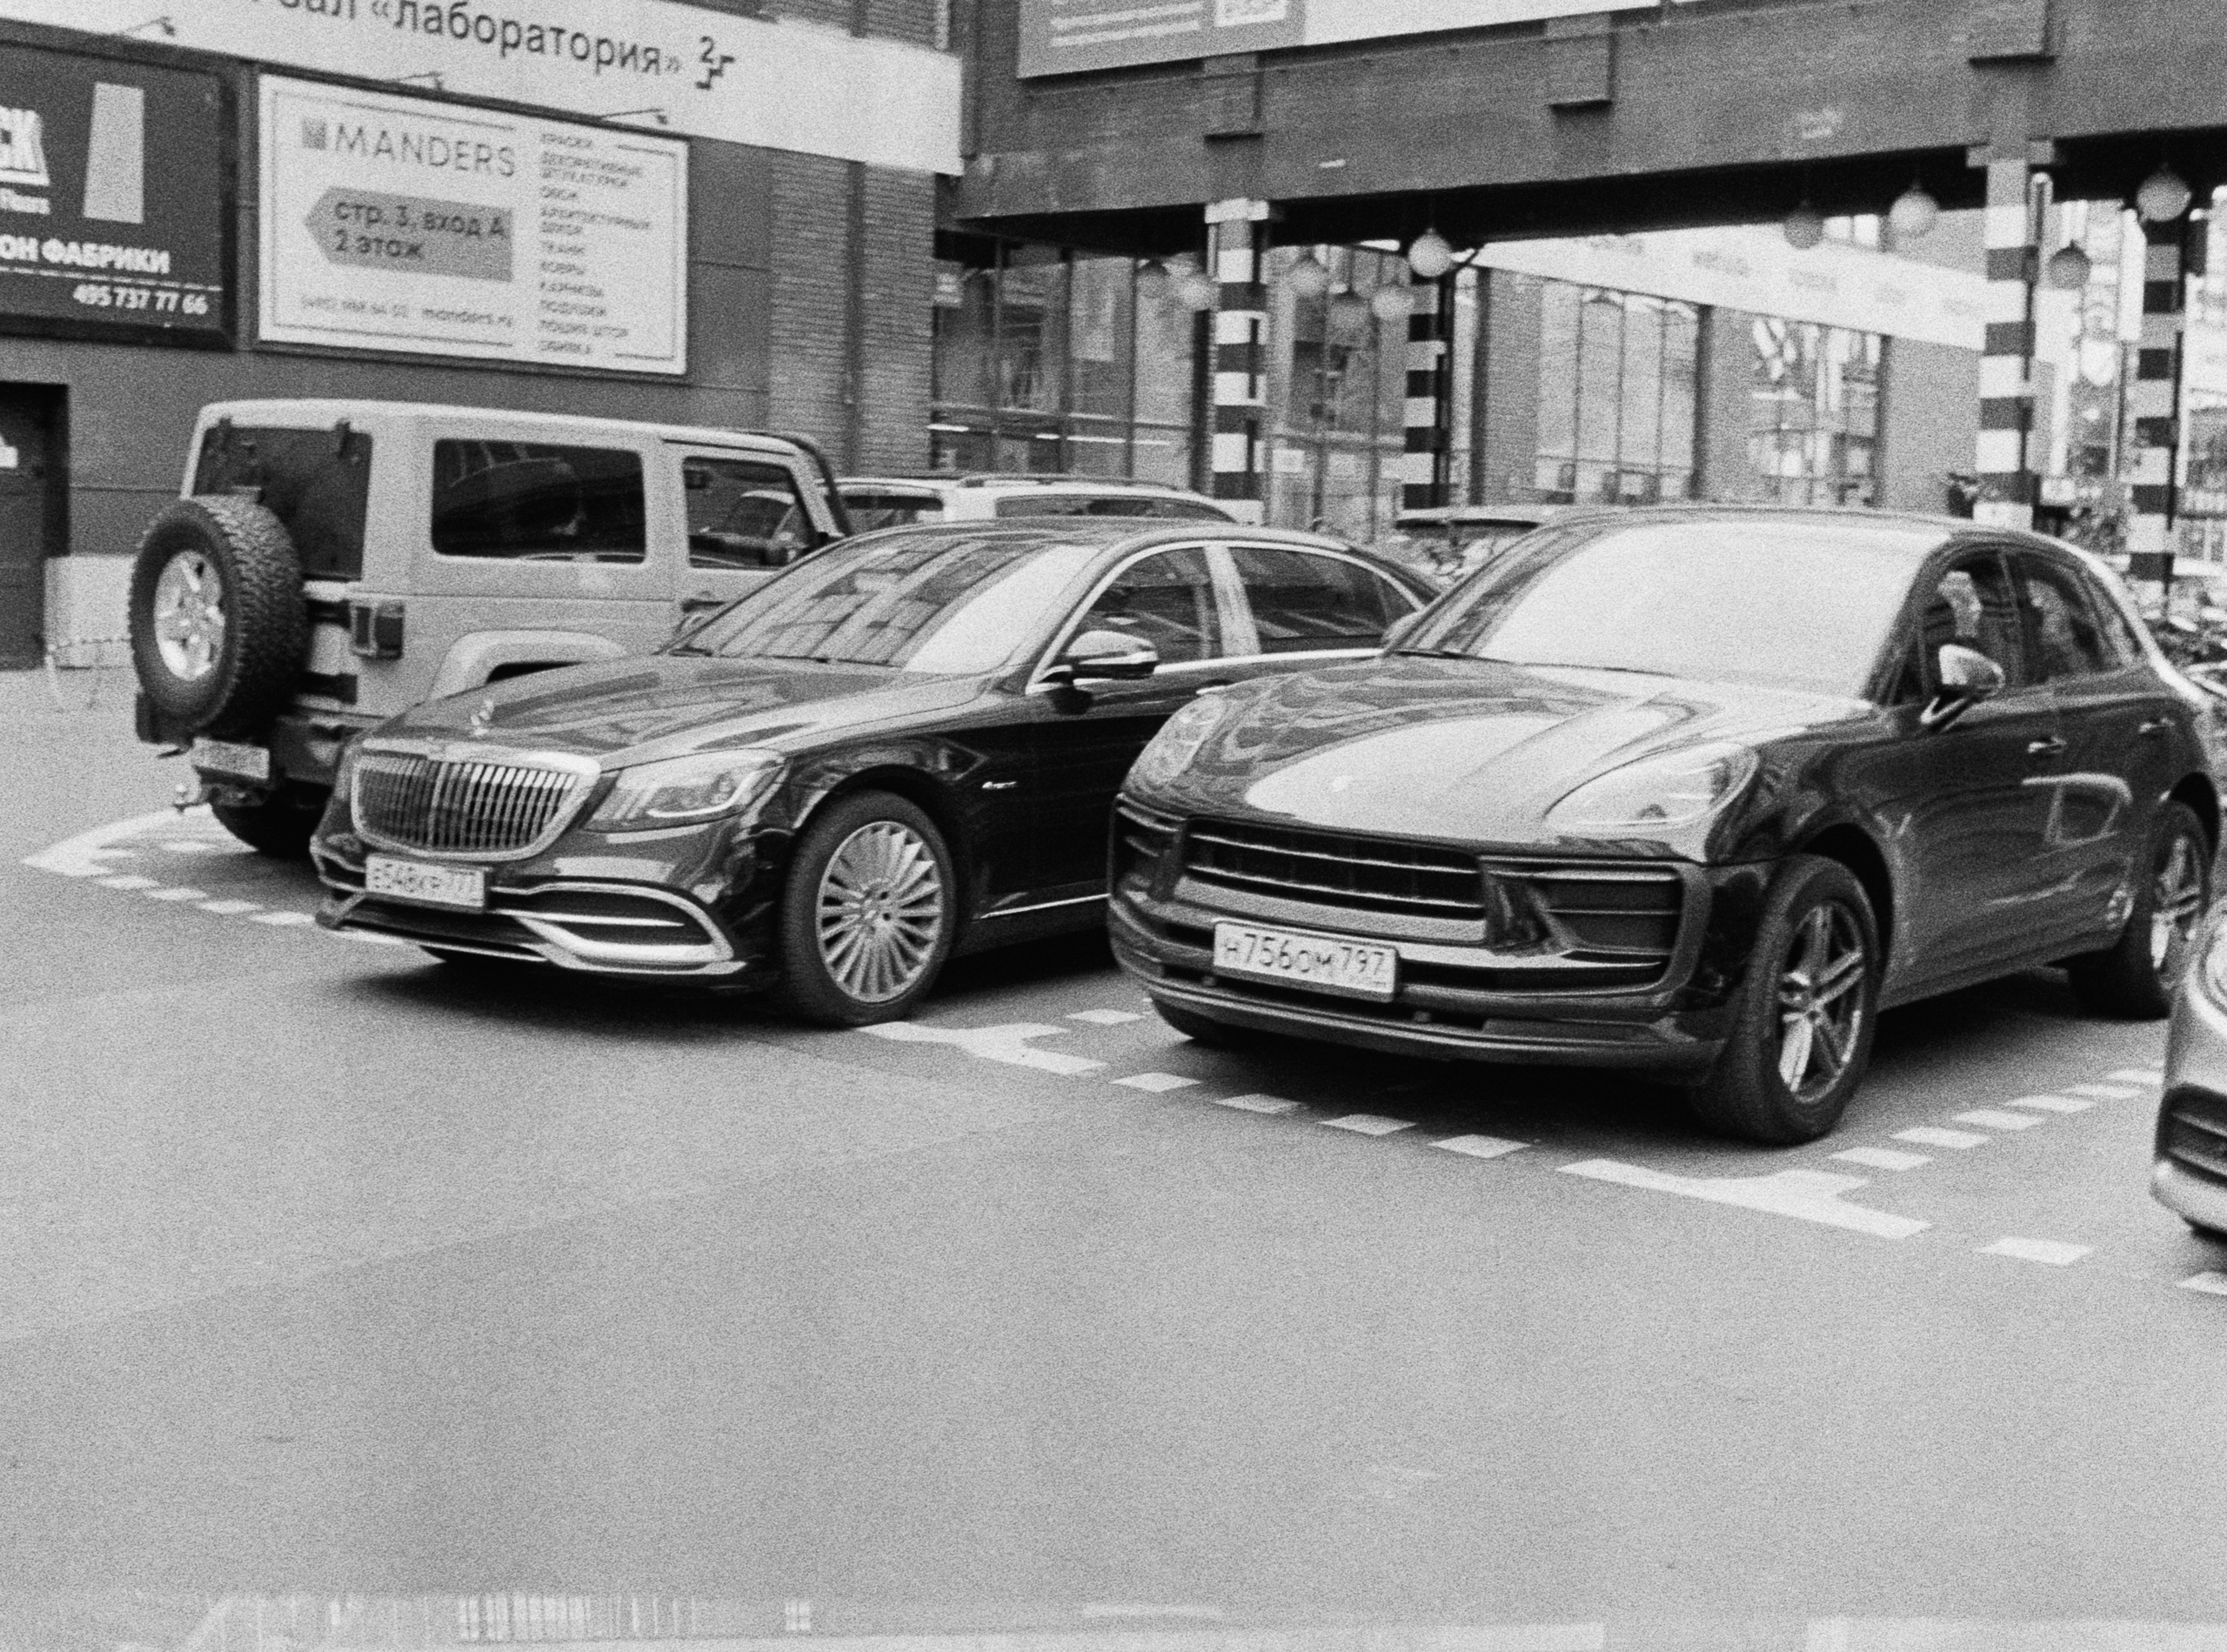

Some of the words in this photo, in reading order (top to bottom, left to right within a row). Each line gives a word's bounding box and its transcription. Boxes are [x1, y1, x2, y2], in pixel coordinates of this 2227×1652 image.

[372, 0, 680, 76] «лаборатория»
[699, 36, 714, 64] 2
[335, 123, 516, 178] MANDERS
[334, 201, 390, 229] стр.
[423, 211, 482, 238] вход
[488, 216, 506, 238] А
[42, 237, 171, 274] ФАБРИКИ
[334, 228, 348, 251] 2
[356, 236, 425, 260] этаж
[155, 290, 179, 312] 77
[182, 293, 208, 316] 66
